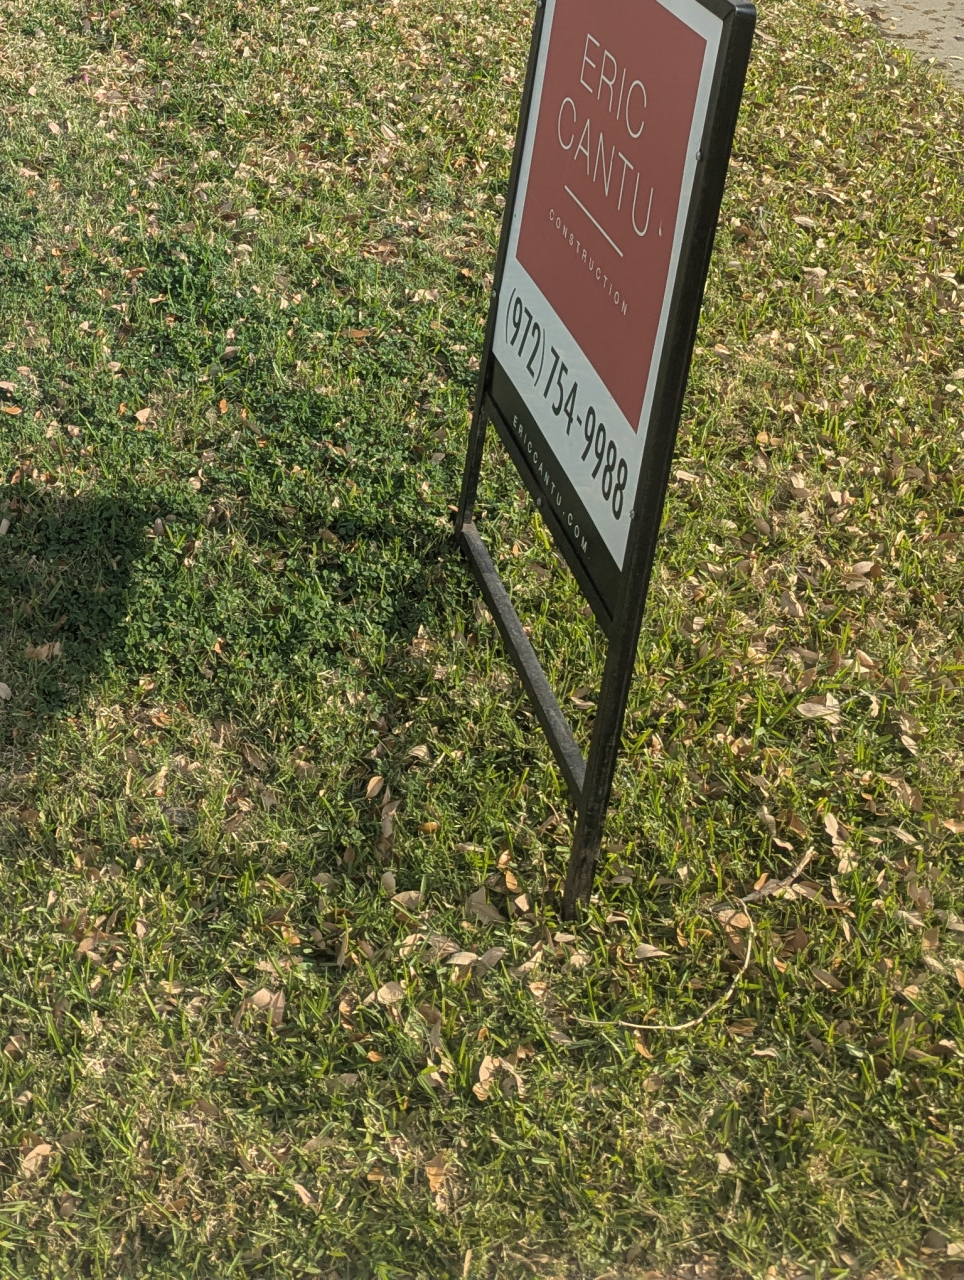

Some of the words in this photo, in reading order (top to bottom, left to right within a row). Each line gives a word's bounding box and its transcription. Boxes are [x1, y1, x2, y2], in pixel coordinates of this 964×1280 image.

[580, 33, 647, 139] ERIC
[557, 97, 654, 237] CANTU
[549, 208, 628, 316] CONSTRUCTION
[505, 287, 546, 387] (972)
[543, 345, 628, 520] 754-9988
[512, 414, 588, 553] ERICCANTU.COM
